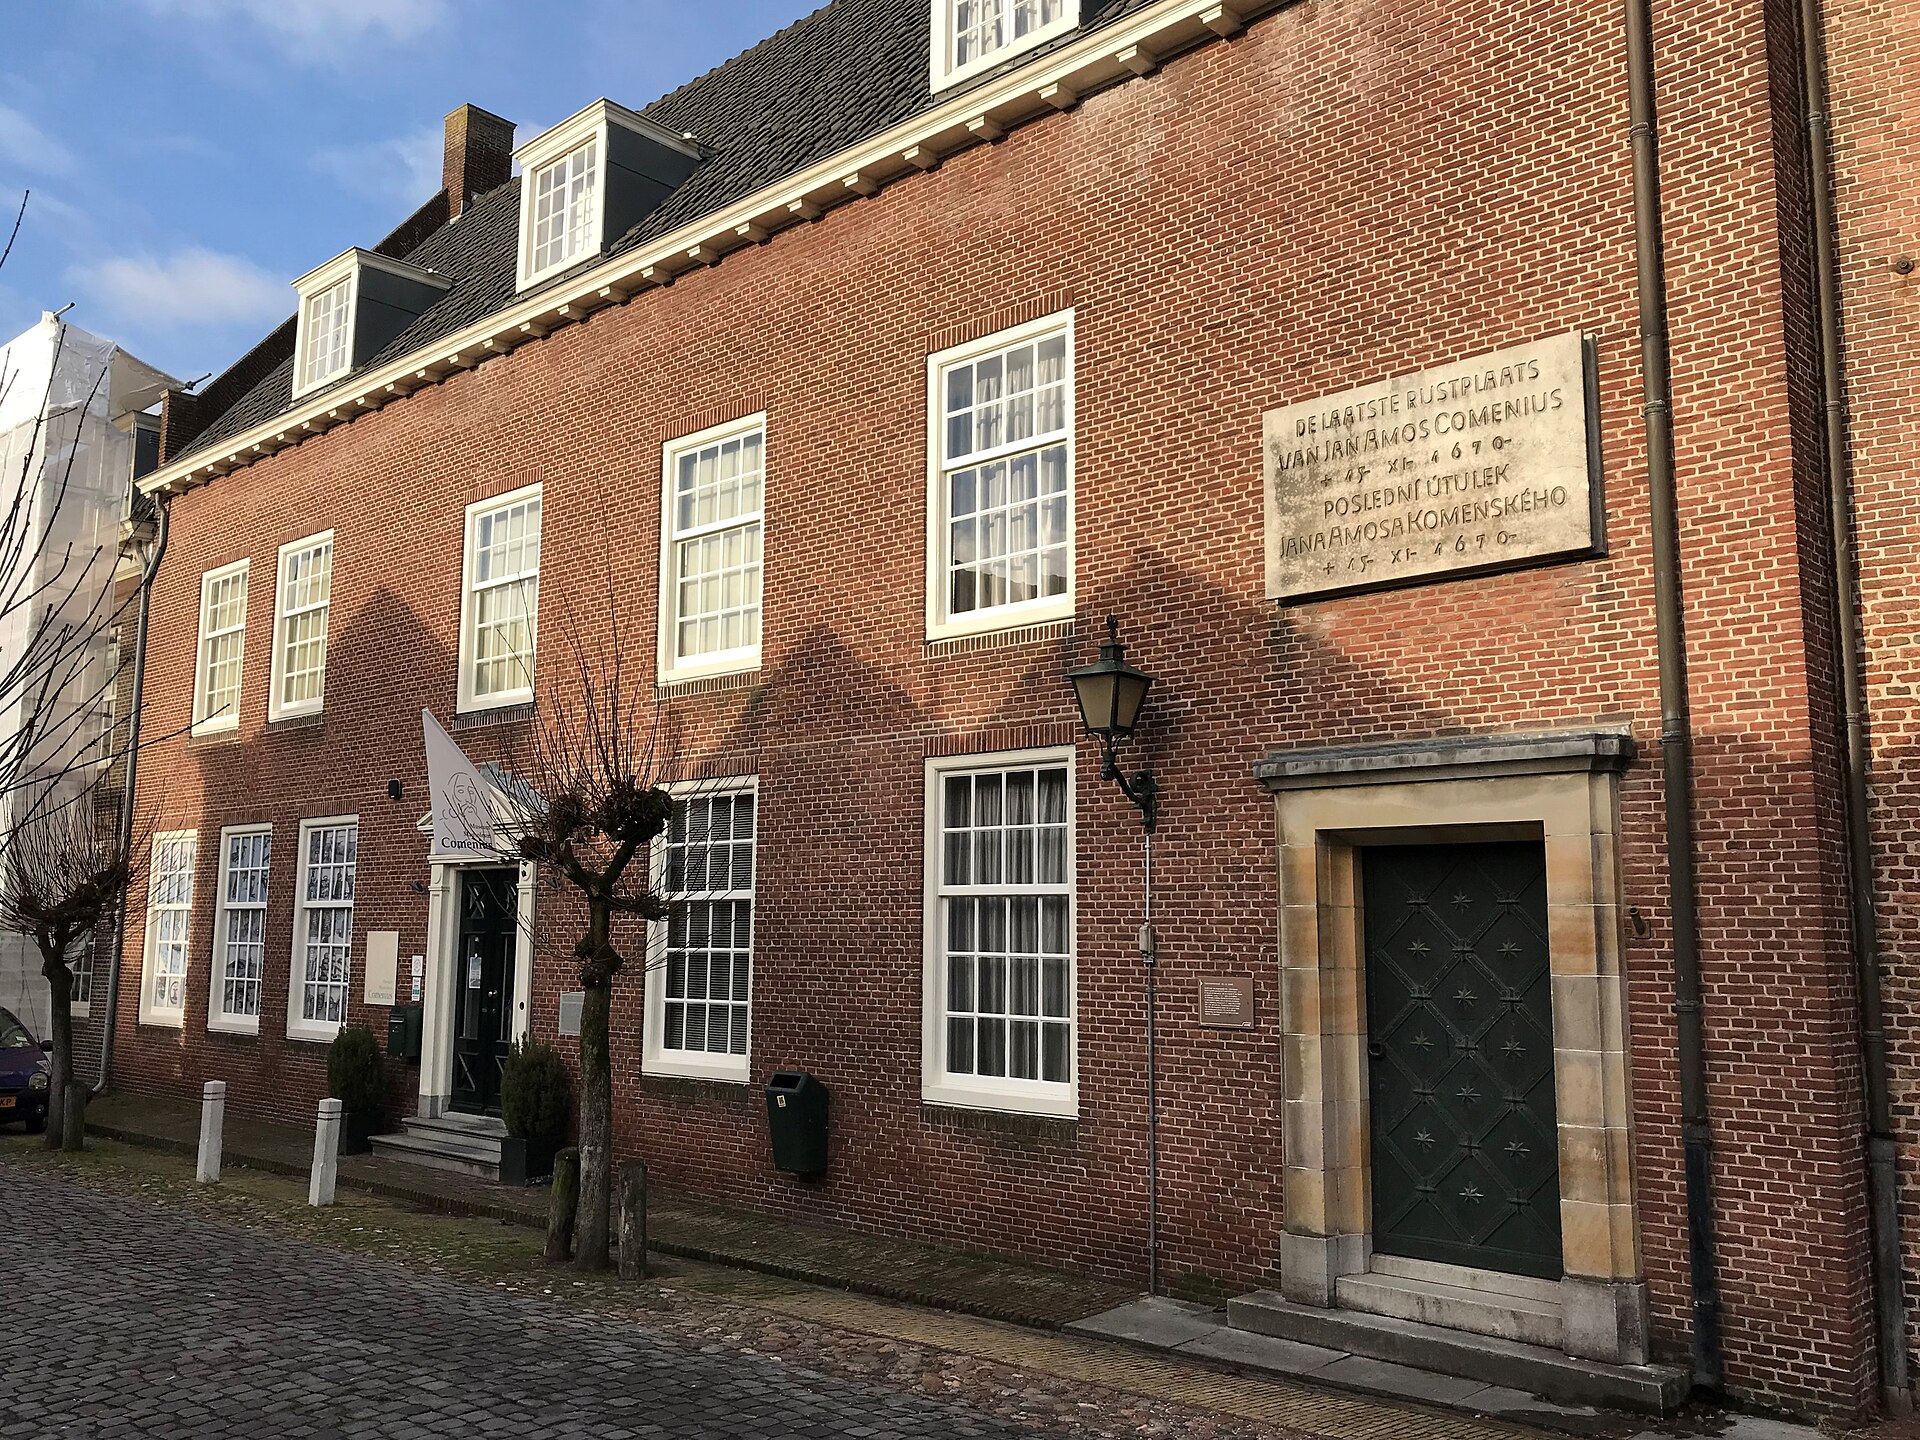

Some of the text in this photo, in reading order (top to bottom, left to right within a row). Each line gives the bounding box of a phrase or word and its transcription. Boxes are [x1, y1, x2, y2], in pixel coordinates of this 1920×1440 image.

[1279, 388, 1563, 471] VAN JAN AMOS COMENIUS
[1296, 359, 1540, 437] DE LAATSTE RUSTPLAATS
[1280, 486, 1568, 558] JANA AMOSA KOMENSKÉHO
[1324, 463, 1510, 519] POSLEDNÍ ÚTULEK
